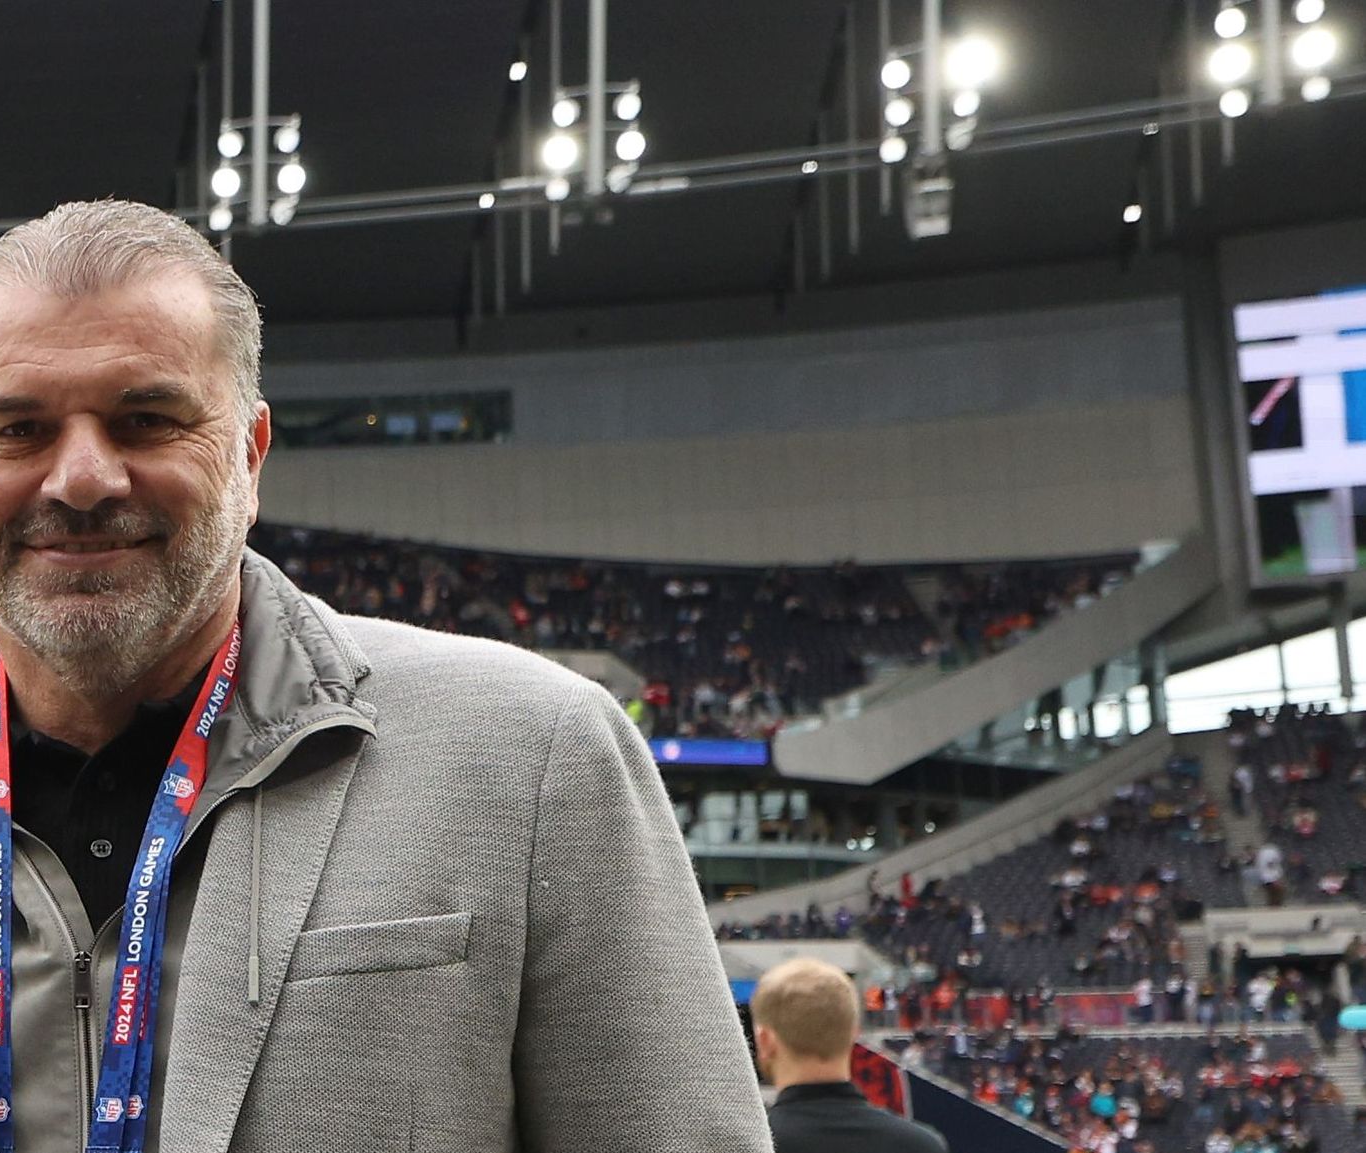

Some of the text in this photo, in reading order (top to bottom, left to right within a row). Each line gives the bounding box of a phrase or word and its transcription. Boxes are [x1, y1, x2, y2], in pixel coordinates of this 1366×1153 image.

[196, 705, 218, 738] 2024
[210, 680, 230, 706] NFL
[115, 837, 165, 1042] 2024 NFL LONDON GAMES
